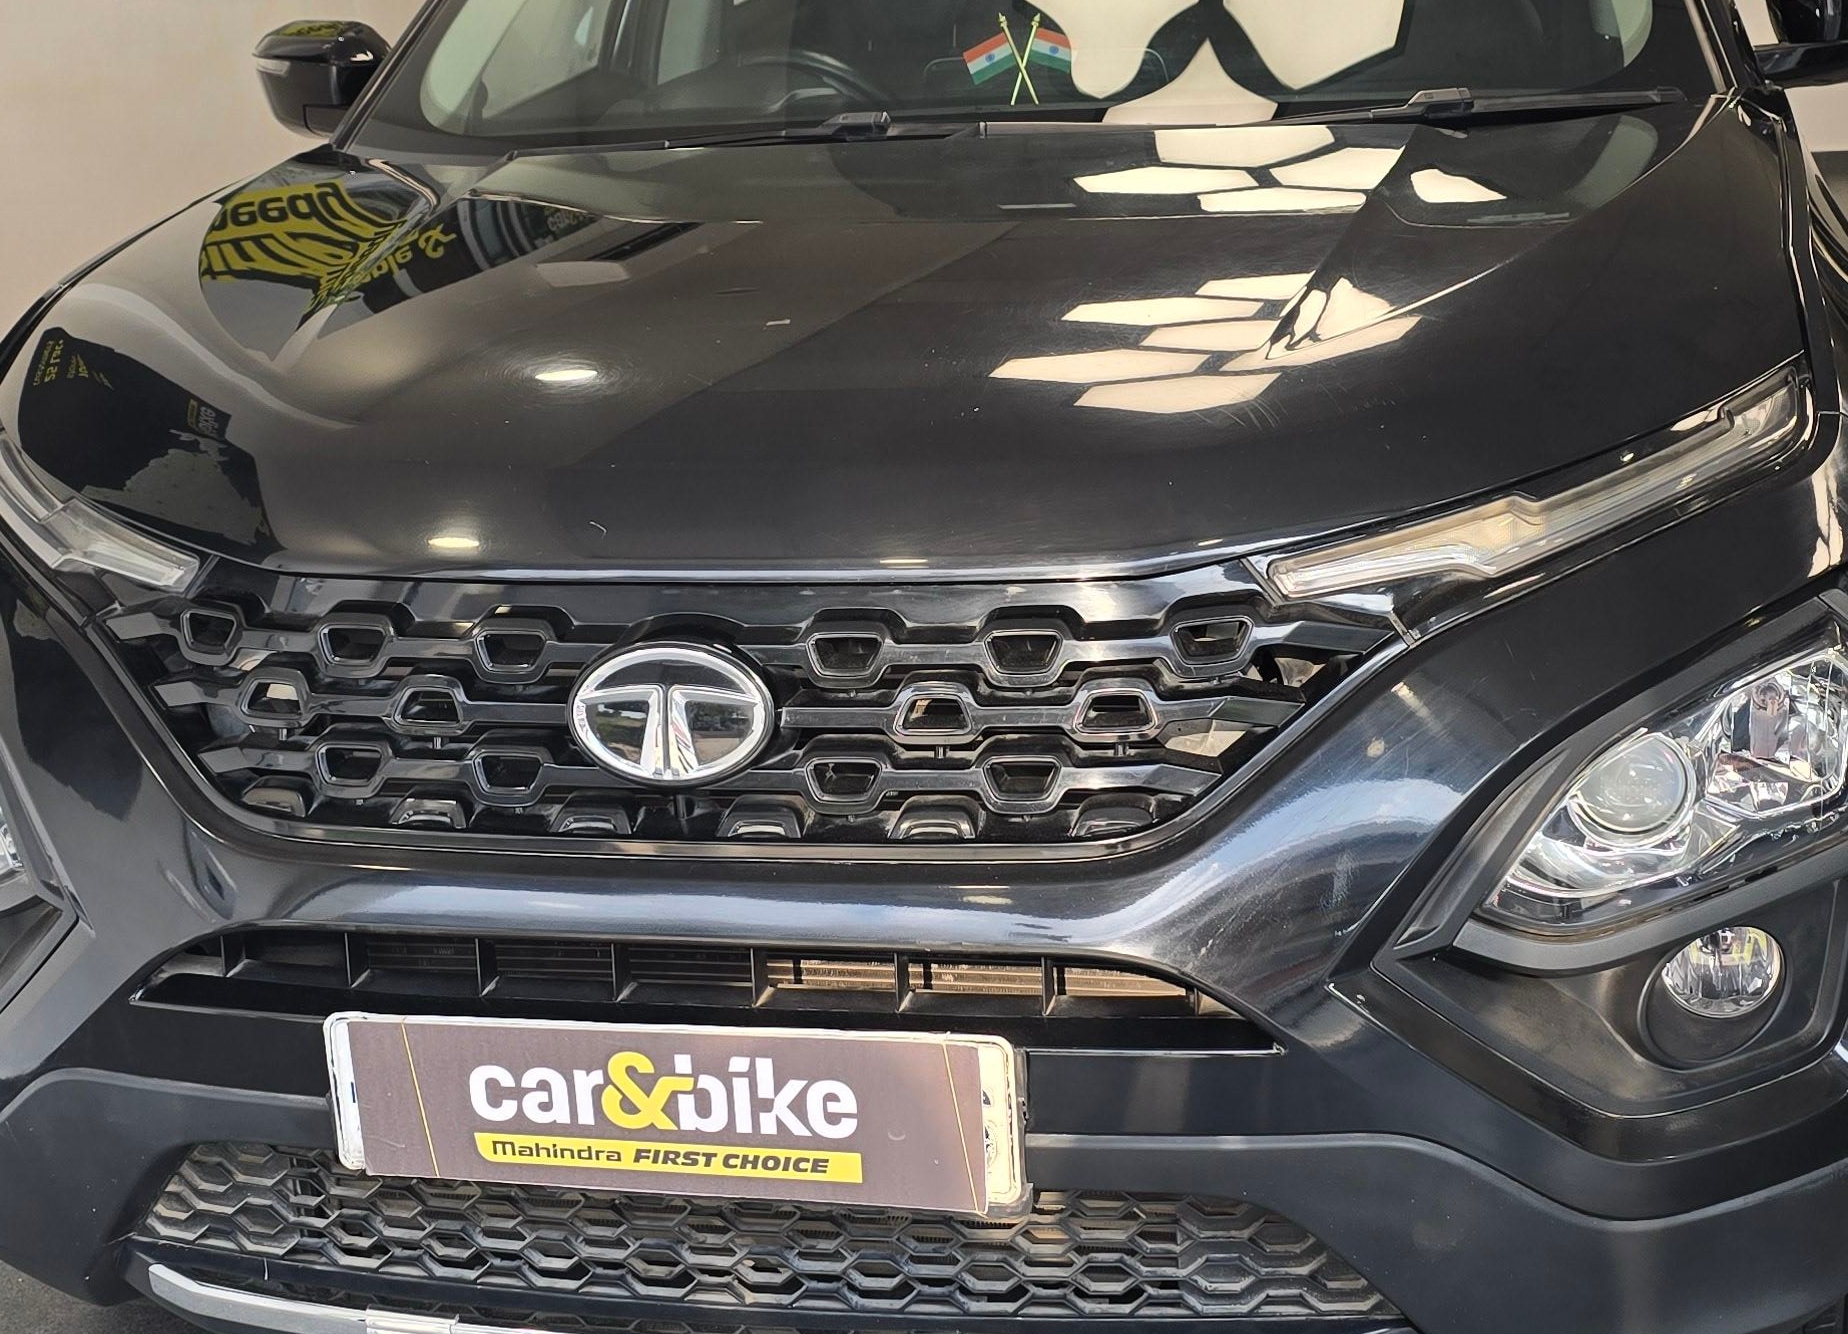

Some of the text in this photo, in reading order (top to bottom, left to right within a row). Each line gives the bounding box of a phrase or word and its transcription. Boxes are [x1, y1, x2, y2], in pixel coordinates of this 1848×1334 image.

[468, 1049, 860, 1140] car&bike
[491, 1139, 830, 1175] Mahindra FIRST CHOICE
